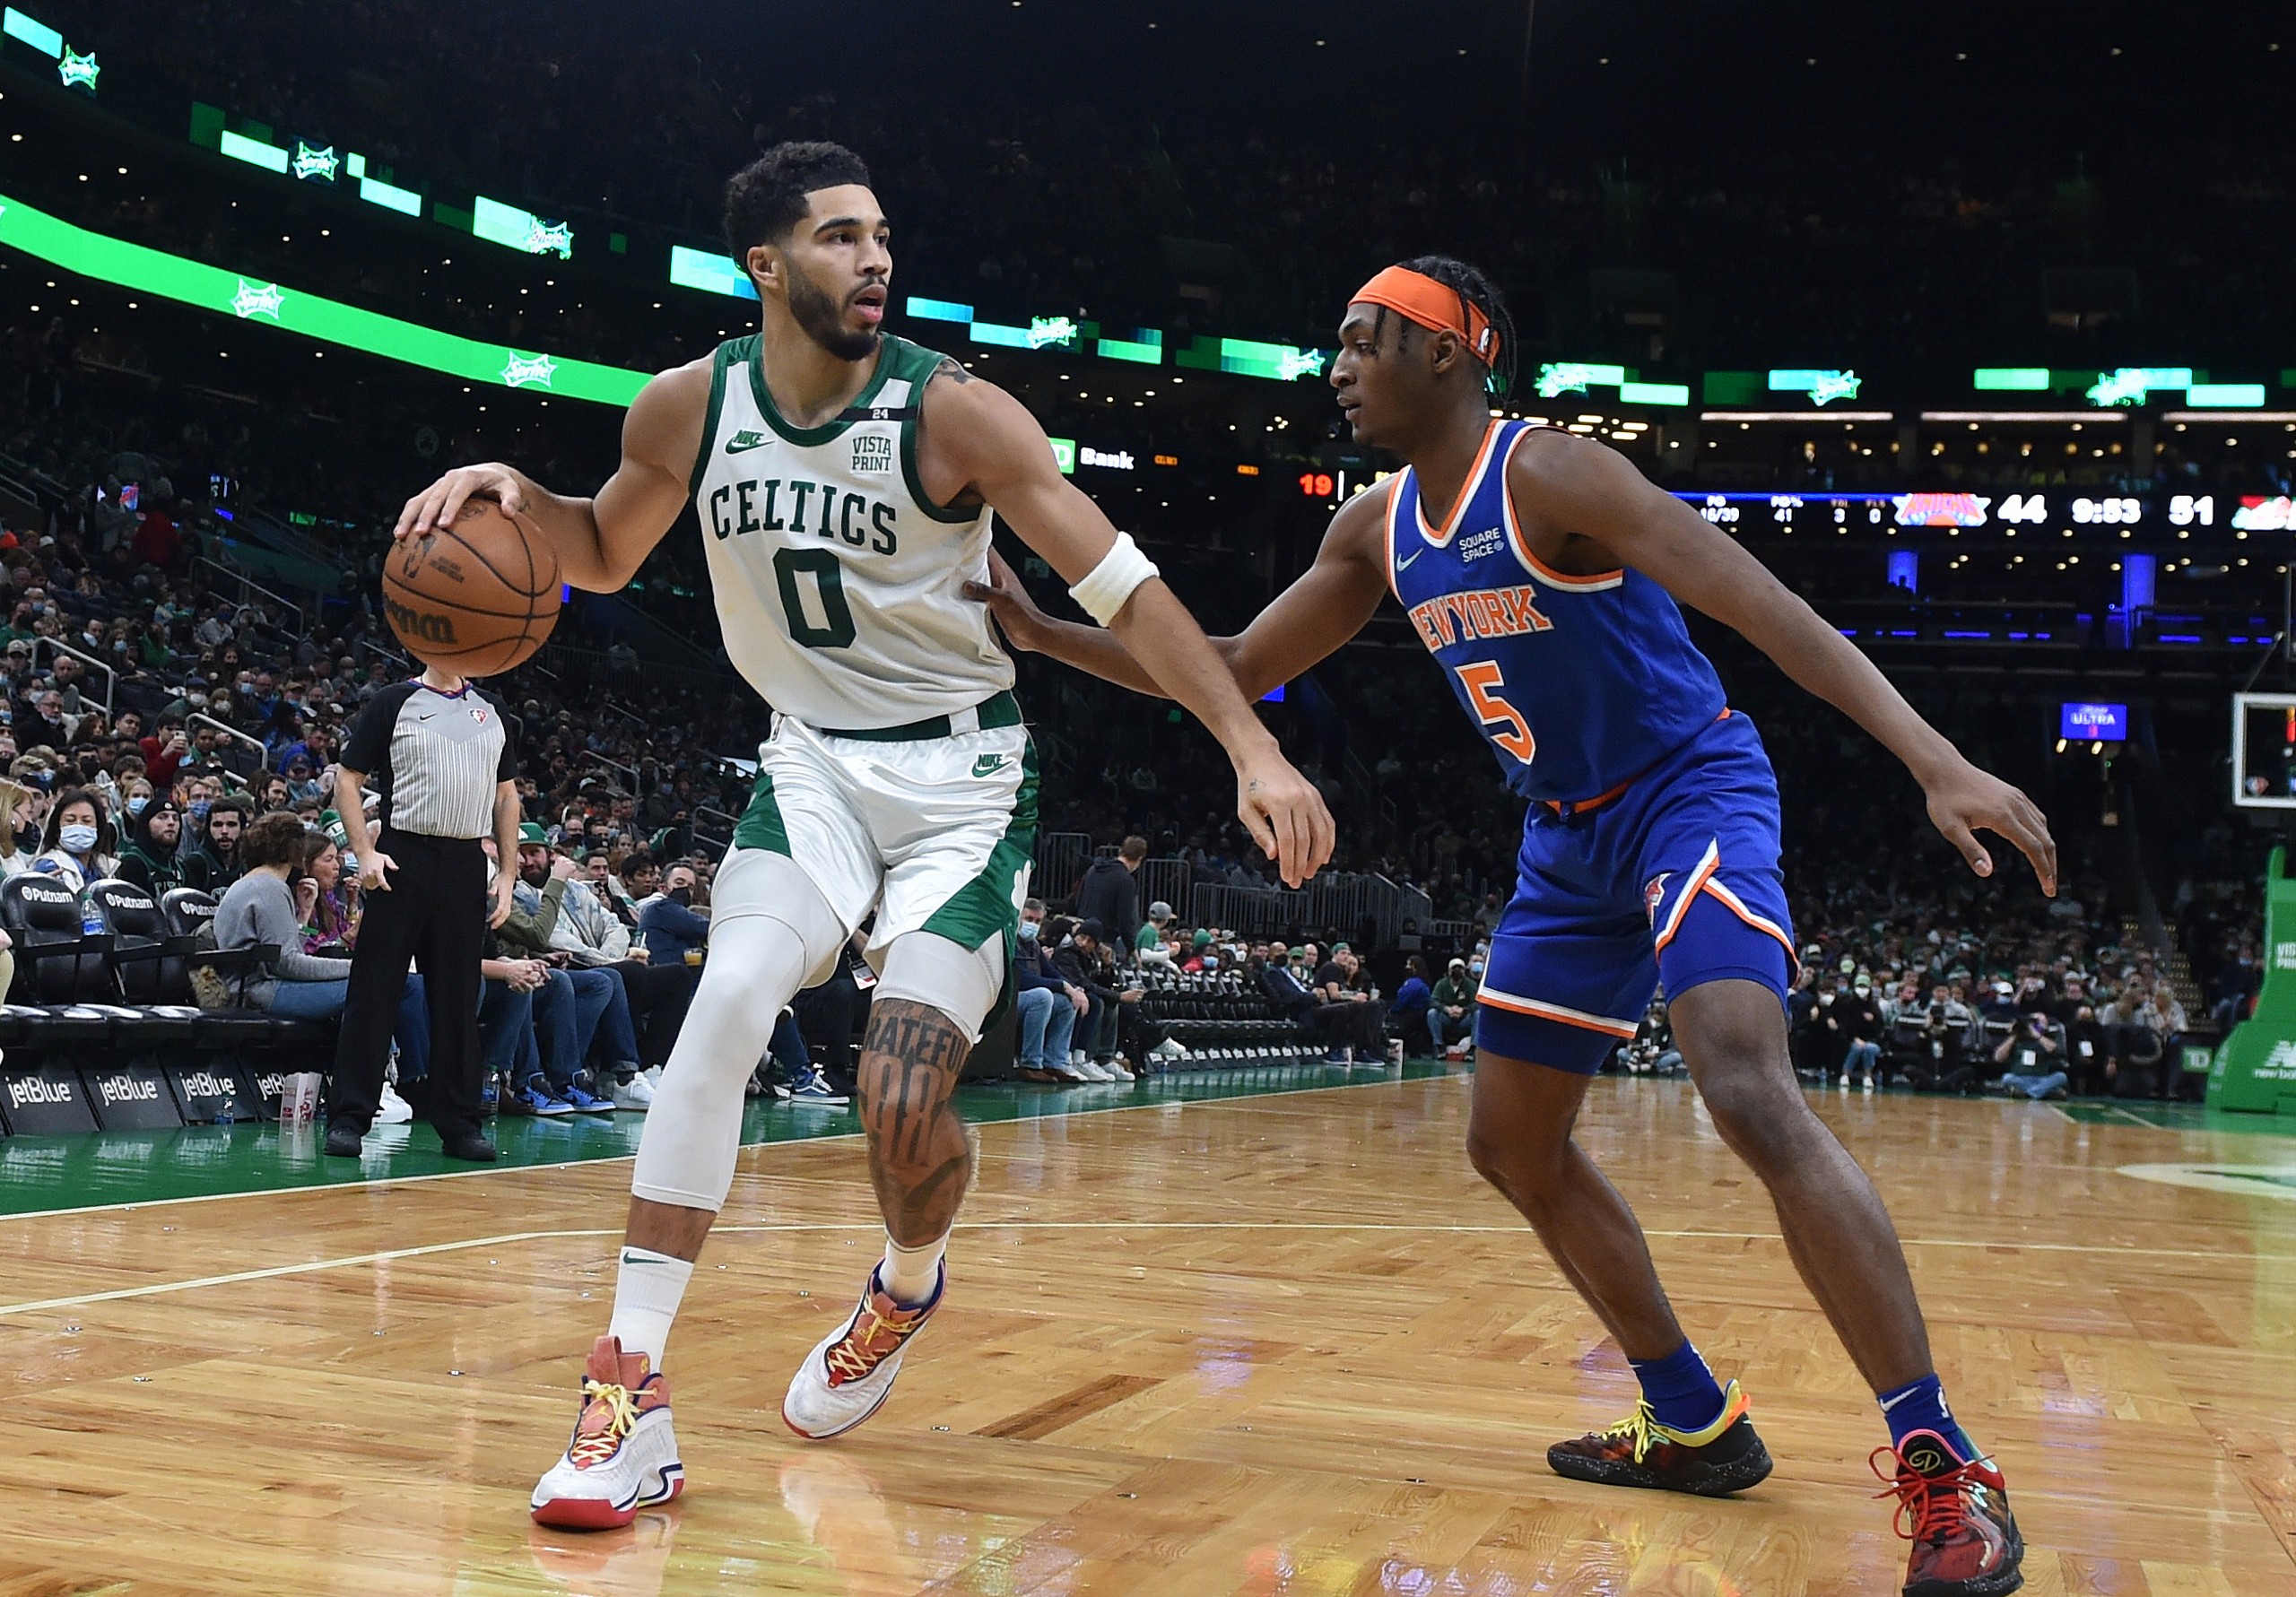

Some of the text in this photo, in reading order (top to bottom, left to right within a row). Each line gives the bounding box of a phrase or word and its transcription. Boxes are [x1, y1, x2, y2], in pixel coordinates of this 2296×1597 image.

[505, 360, 549, 379] Sprite
[872, 408, 889, 419] 24
[733, 429, 764, 446] NIKE
[852, 436, 891, 456] VISTA
[851, 455, 891, 472] PRINT
[1050, 443, 1073, 467] D
[1080, 447, 1135, 470] Bank
[1300, 473, 1334, 496] 19
[710, 479, 898, 556] CELTICS
[1774, 508, 1793, 523] 41
[1833, 508, 1846, 524] 3
[1868, 508, 1882, 524] 0
[1997, 494, 2048, 525] 44
[2072, 498, 2142, 525] 9:53
[2169, 495, 2214, 526] 51
[1458, 527, 1501, 551] SQUARE
[1462, 542, 1495, 563] SPACE
[772, 547, 857, 649] 0
[1446, 585, 1555, 642] YORK
[1454, 659, 1536, 766] 5
[2070, 712, 2117, 725] ULTRA
[978, 753, 1004, 768] NIKE
[33, 888, 74, 904] Putnam
[117, 894, 154, 909] Putnam
[5, 1076, 72, 1109] jetBlue
[96, 1075, 159, 1107] jetBlue
[178, 1072, 237, 1102] jetBlue
[255, 1072, 285, 1101] jetB
